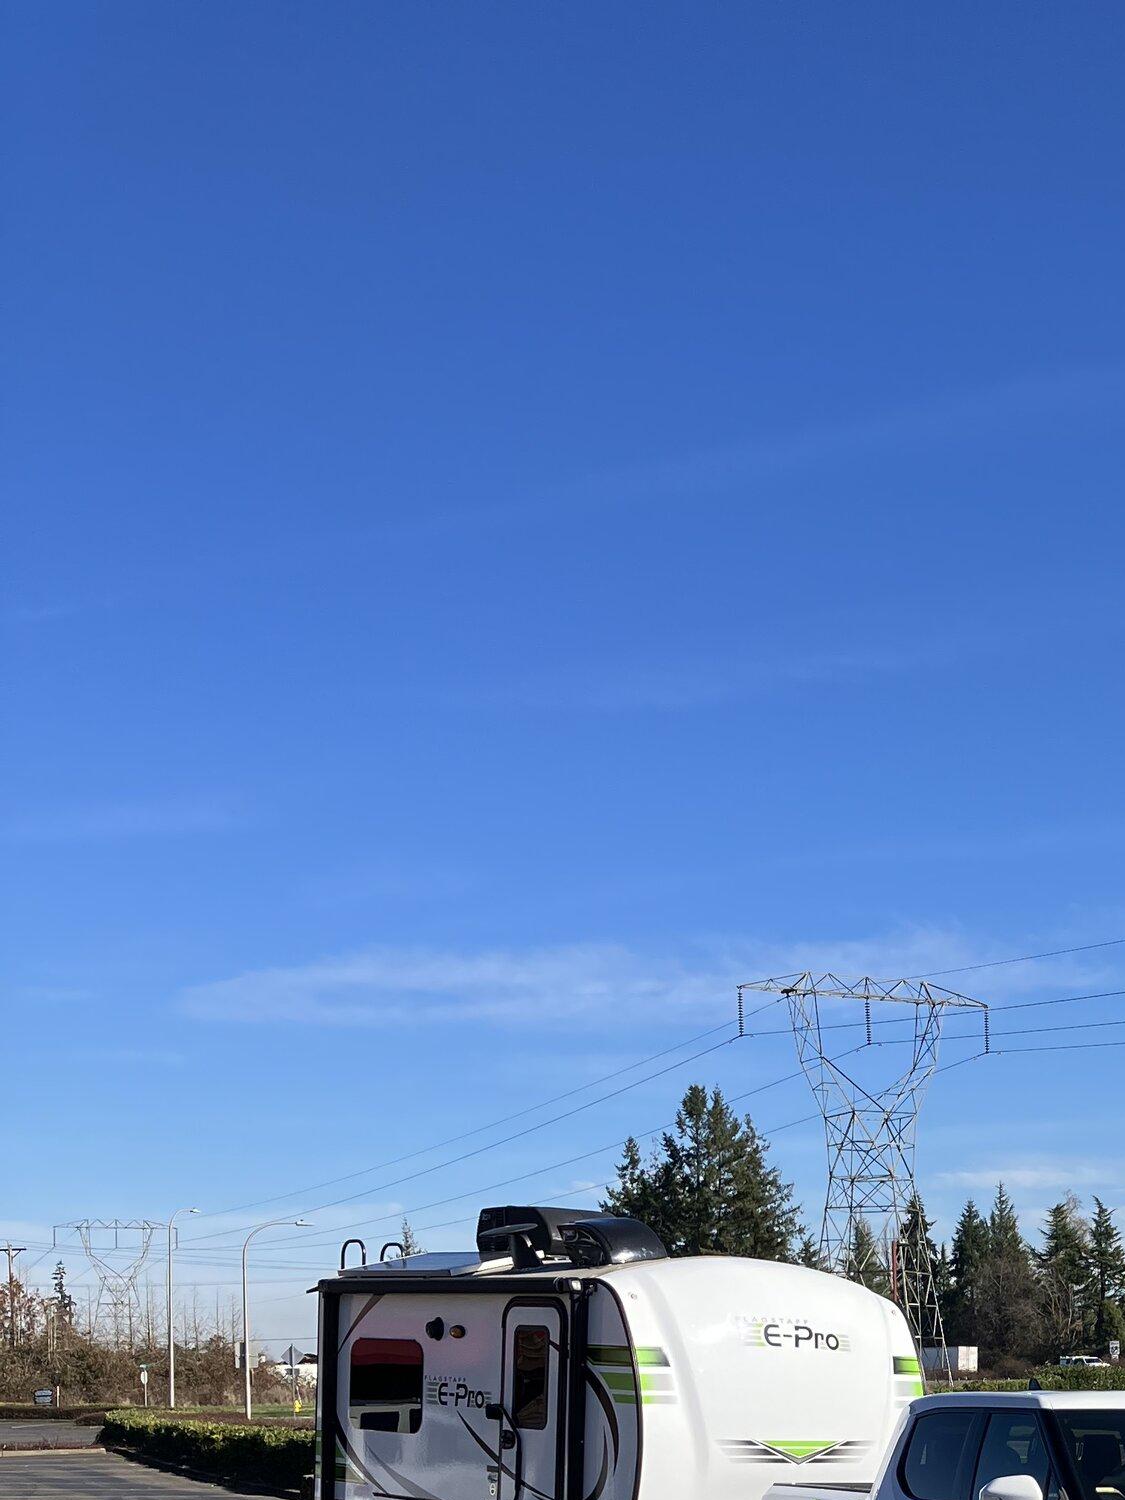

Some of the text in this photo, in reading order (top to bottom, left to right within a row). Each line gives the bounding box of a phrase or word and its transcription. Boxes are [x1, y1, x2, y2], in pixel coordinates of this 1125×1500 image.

[763, 1323, 840, 1351] E-Pro
[424, 1374, 467, 1383] FLAGSTAFF
[438, 1382, 485, 1409] E-Pro
